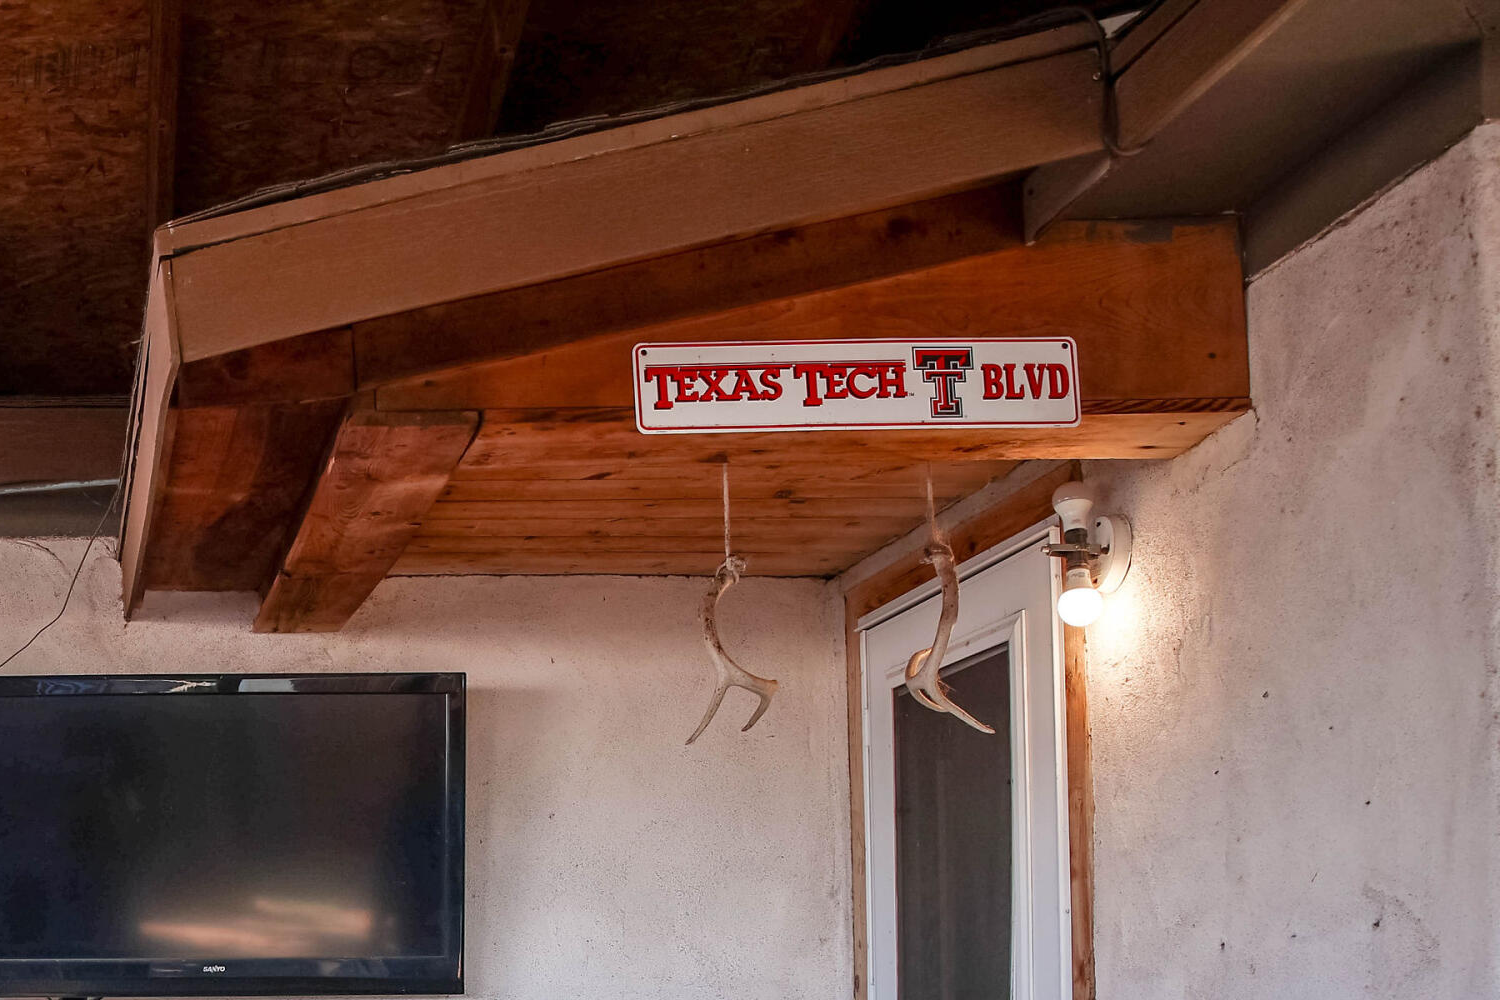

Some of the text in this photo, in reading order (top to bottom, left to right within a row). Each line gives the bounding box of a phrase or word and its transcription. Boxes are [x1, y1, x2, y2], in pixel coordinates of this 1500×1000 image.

[644, 364, 783, 410] TEXAS
[793, 361, 908, 407] TECH
[980, 363, 1070, 400] BLVD
[202, 964, 226, 973] SANYO
